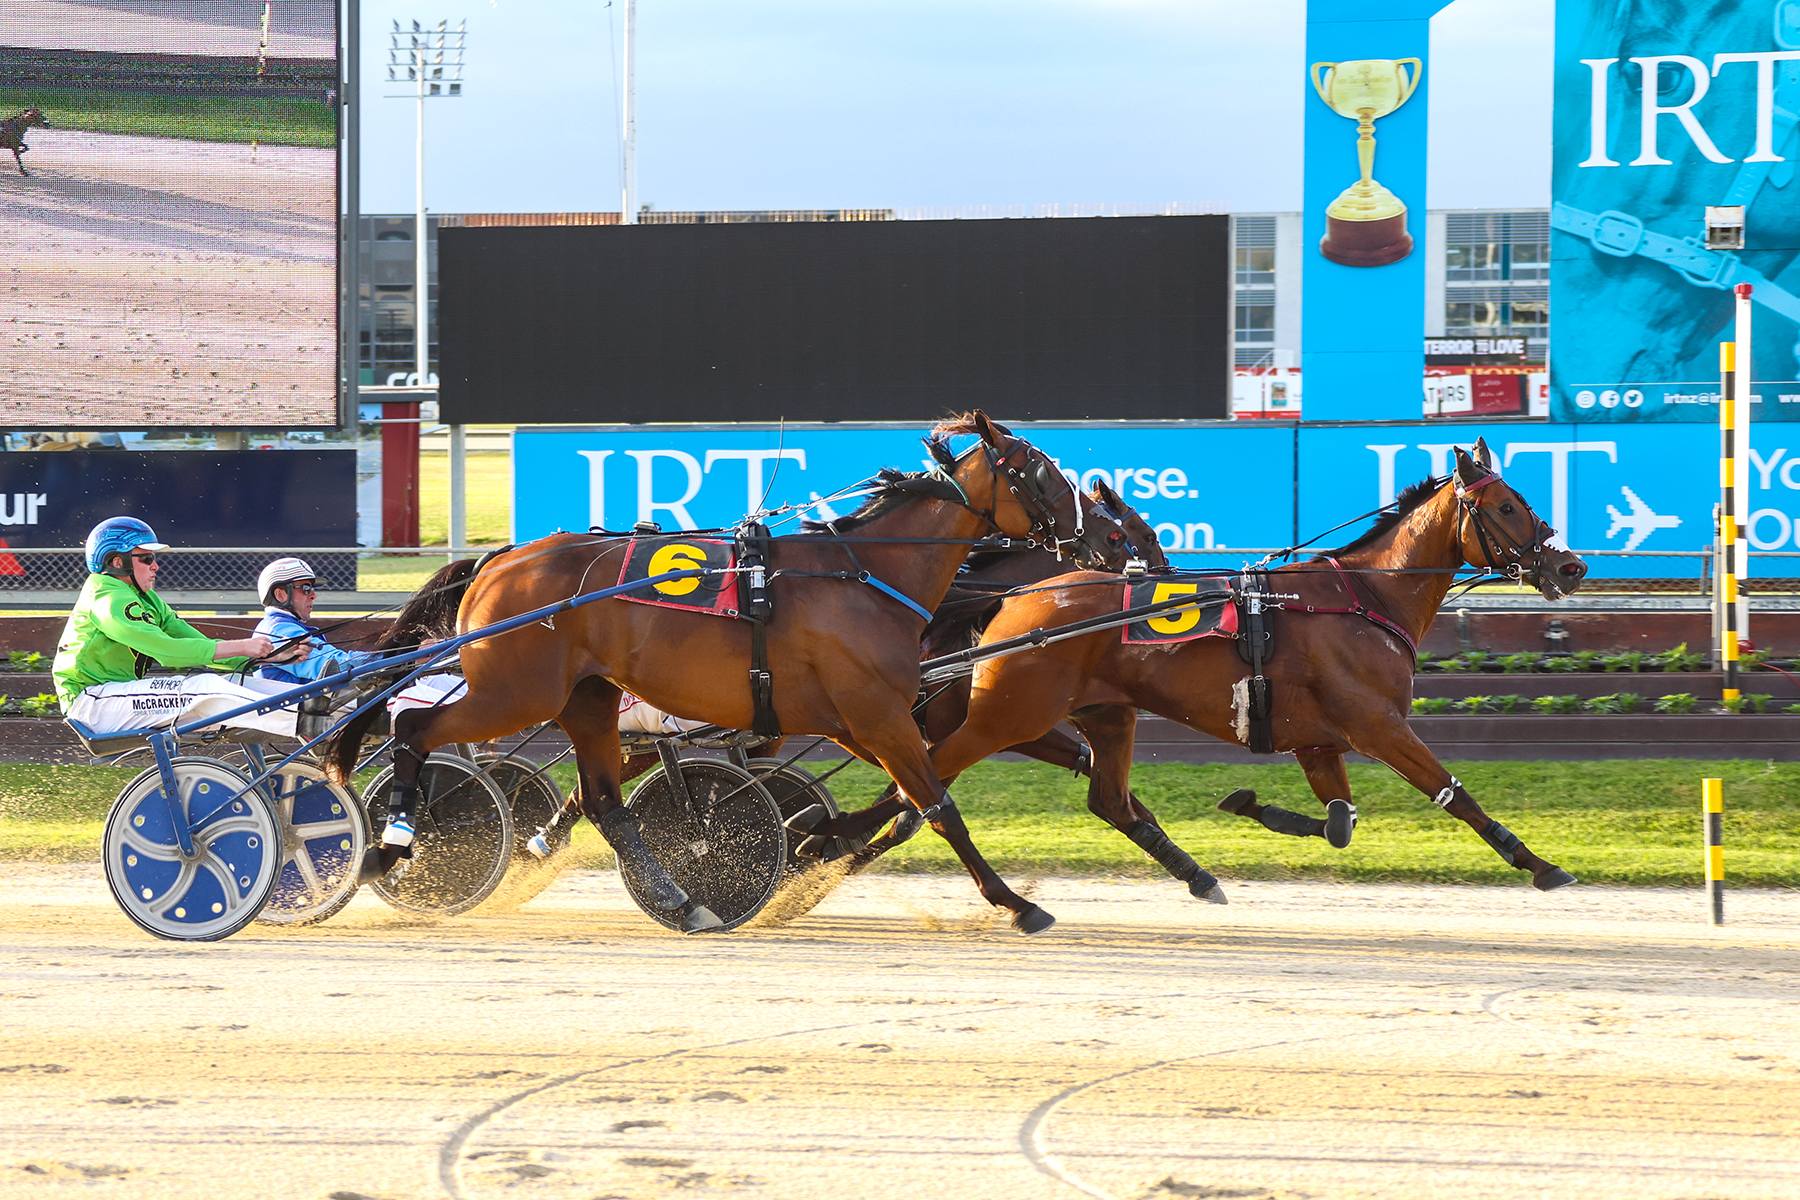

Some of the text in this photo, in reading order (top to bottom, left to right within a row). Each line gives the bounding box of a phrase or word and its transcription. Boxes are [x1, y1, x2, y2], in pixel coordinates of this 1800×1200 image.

[1578, 50, 1800, 168] IRT
[1490, 339, 1524, 354] LOVE
[0, 493, 47, 526] ur
[577, 449, 807, 534] IRT
[1745, 508, 1800, 550] O
[648, 544, 708, 596] 6
[1147, 582, 1201, 635] 5
